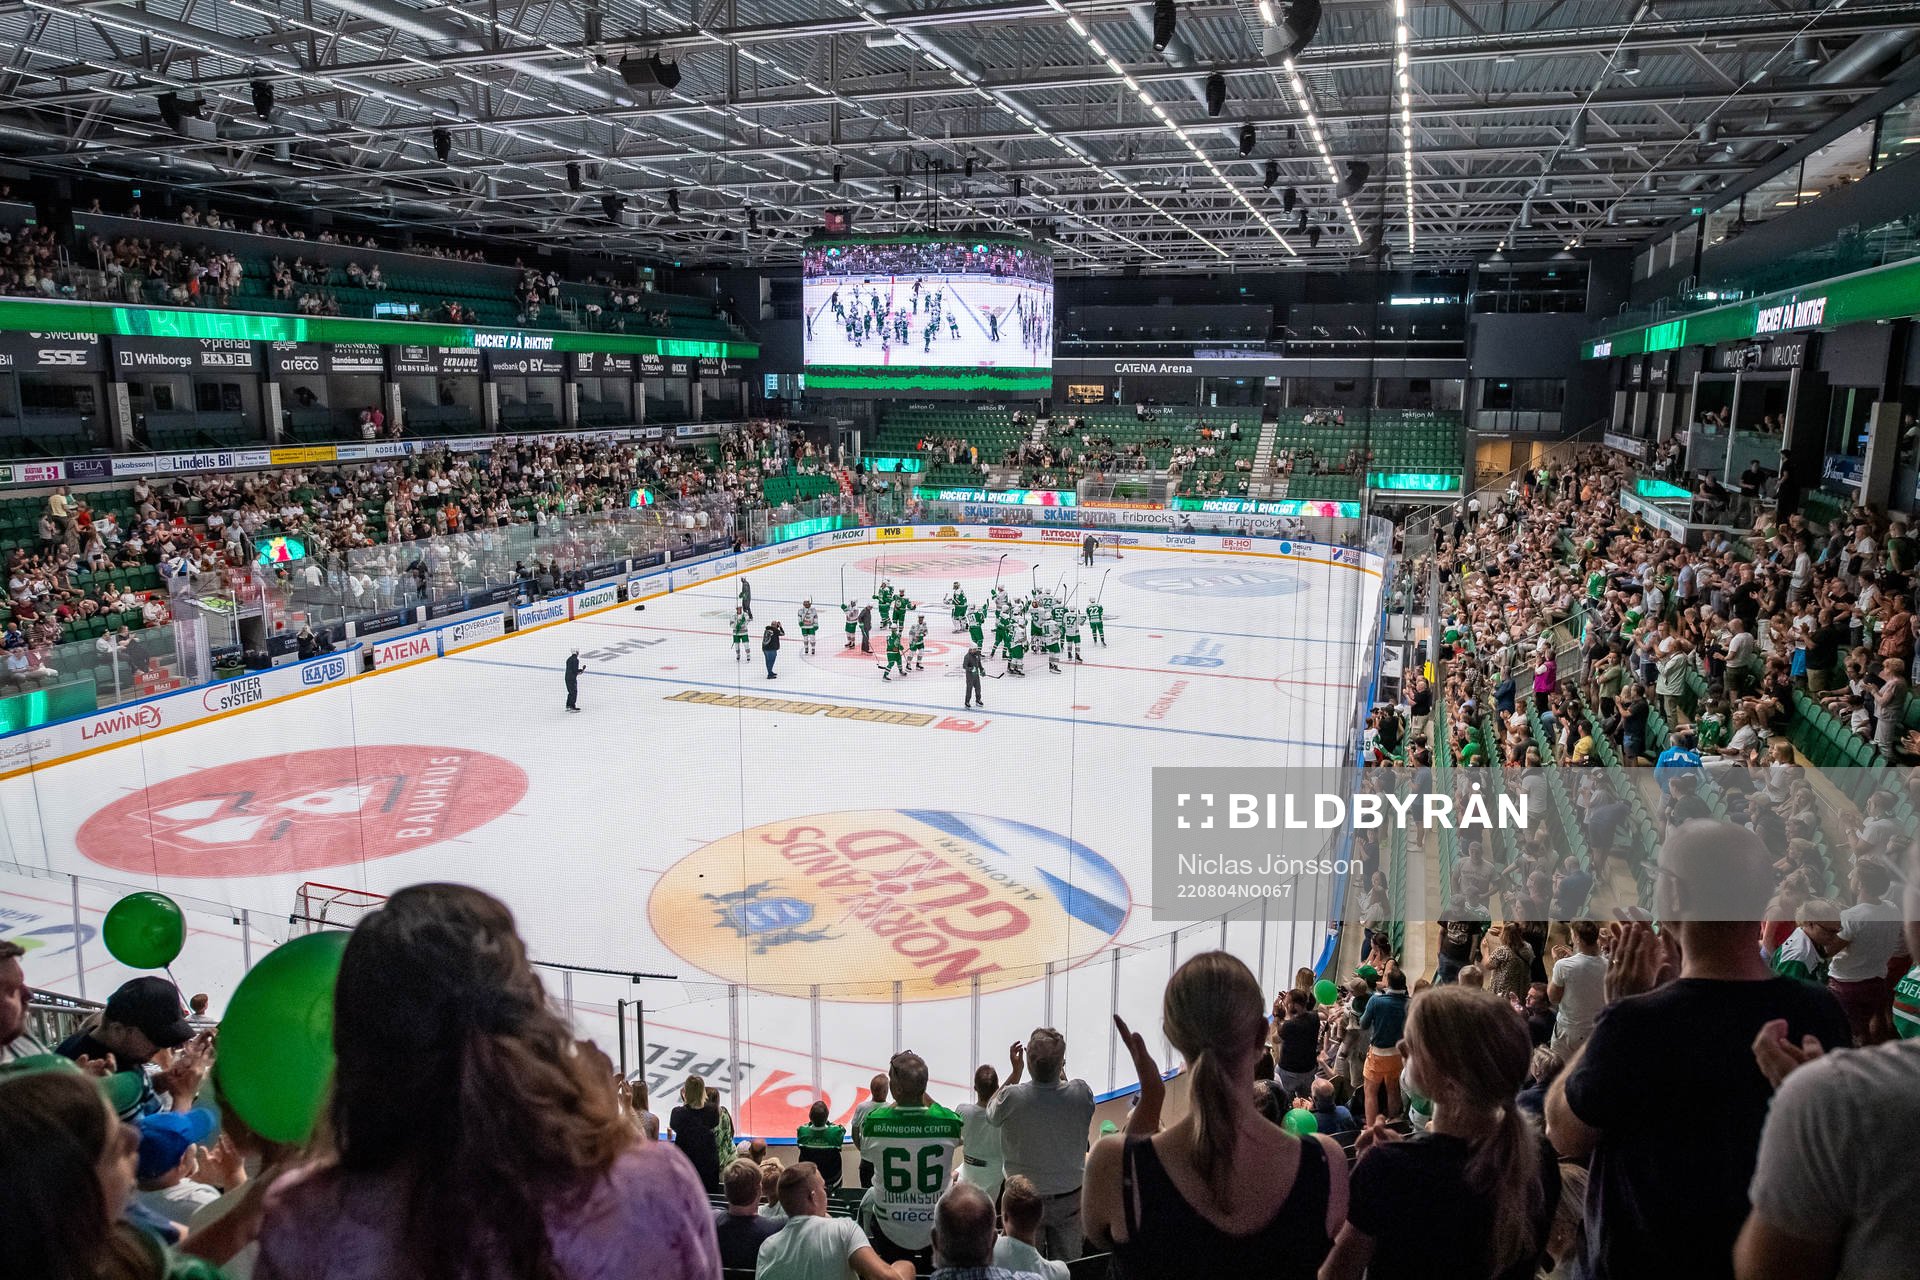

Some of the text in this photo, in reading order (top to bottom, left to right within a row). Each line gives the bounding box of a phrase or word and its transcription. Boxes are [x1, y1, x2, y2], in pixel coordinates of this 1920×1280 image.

[1756, 295, 1827, 333] HOCKEY PÅ RIKTIGT
[475, 333, 509, 348] HOCKEY
[510, 332, 522, 349] PÅ
[524, 336, 554, 350] RIKTIGT
[37, 350, 88, 365] SSE
[134, 352, 192, 367] Wihlborgs
[281, 359, 319, 371] areco
[492, 362, 519, 371] wedbank
[530, 359, 543, 371] EY
[1114, 363, 1192, 373] CATENA Arena
[73, 460, 104, 471] BELLA
[113, 460, 153, 470] Jakobssons
[173, 454, 214, 470] Lindells
[219, 453, 232, 467] Bil
[940, 490, 972, 501] HOCKEY
[973, 489, 985, 502] PÅ
[1203, 500, 1295, 514] HOCKEY PÅ RIKTIGT
[1122, 511, 1175, 524] Fribrocks
[832, 529, 864, 541] HiKOKI
[884, 528, 901, 536] MVB
[1165, 535, 1196, 545] bravida
[1224, 539, 1250, 547] ER-HO
[1292, 543, 1312, 551] Resurs
[1343, 550, 1360, 559] INTER
[578, 591, 615, 610] AGRIZON
[374, 637, 430, 666] CATENA
[304, 661, 344, 682] KAABS
[230, 677, 261, 695] INTER
[220, 688, 262, 709] SYSTEM
[396, 754, 463, 839] BAUHAUS
[934, 837, 1042, 903] ALKOHOLFRI
[883, 1144, 945, 1194] 66
